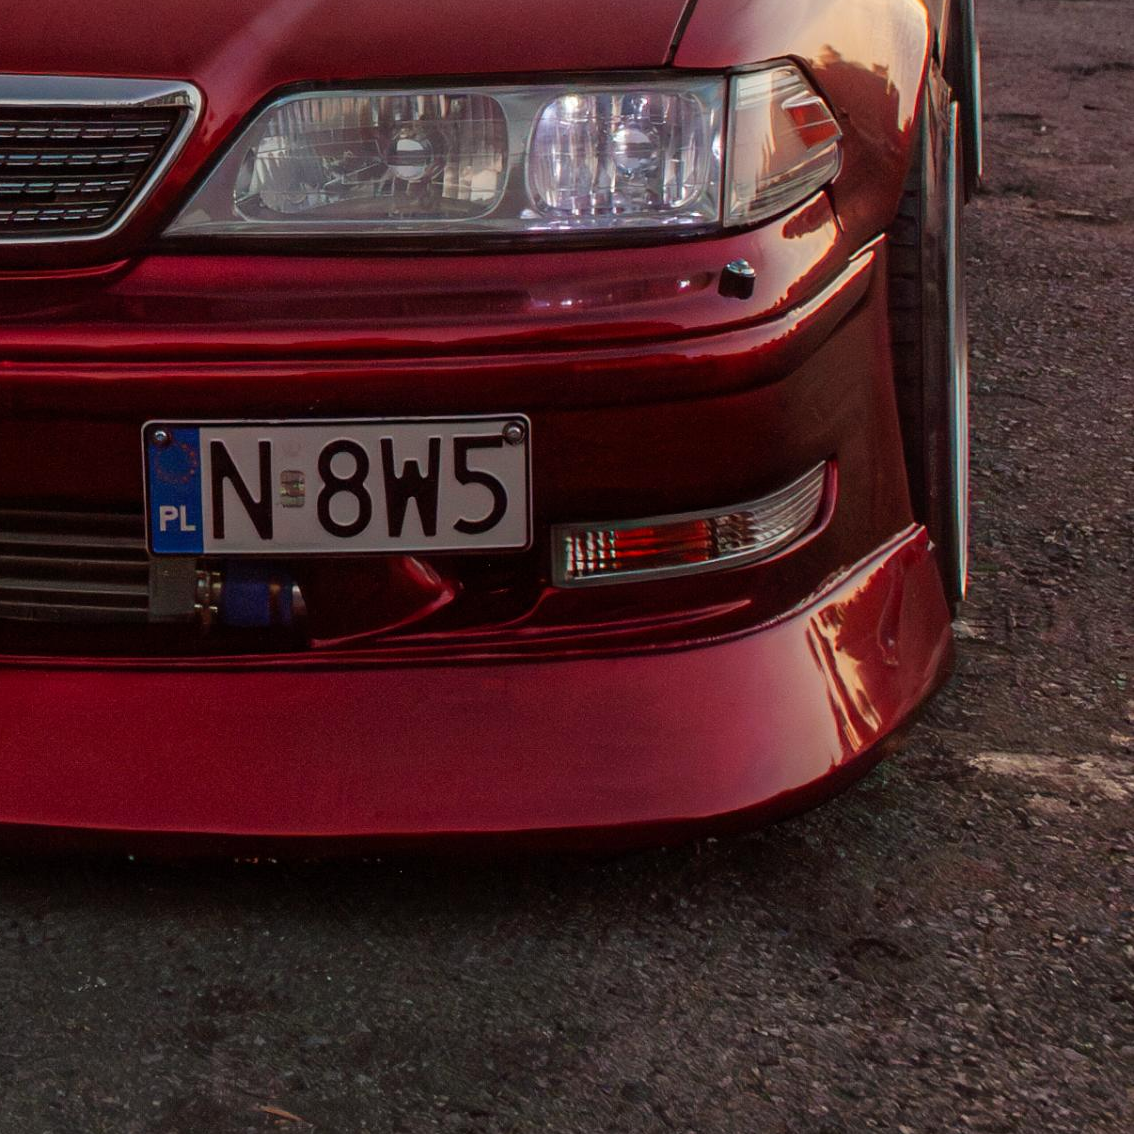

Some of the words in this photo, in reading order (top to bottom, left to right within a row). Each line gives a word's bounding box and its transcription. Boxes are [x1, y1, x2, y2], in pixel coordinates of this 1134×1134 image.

[159, 505, 197, 532] PL
[210, 439, 273, 540] N
[317, 435, 508, 538] 8W5
